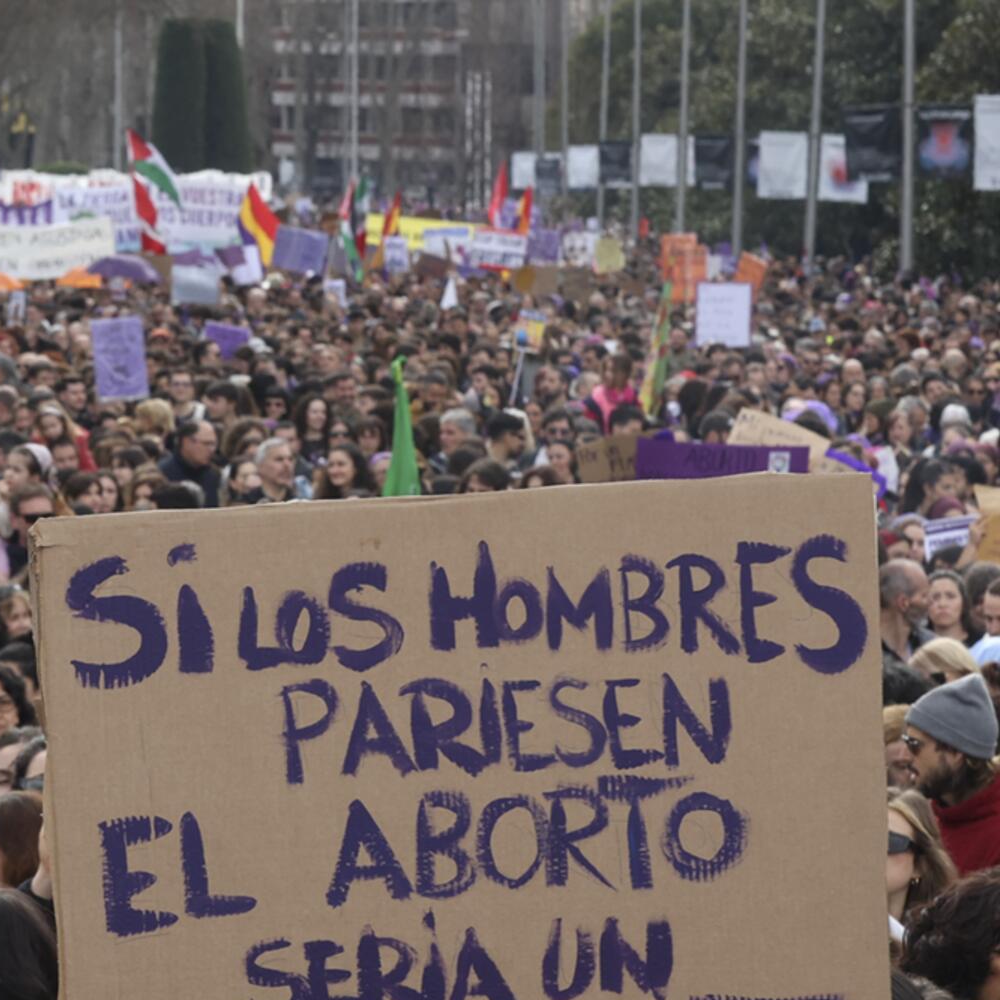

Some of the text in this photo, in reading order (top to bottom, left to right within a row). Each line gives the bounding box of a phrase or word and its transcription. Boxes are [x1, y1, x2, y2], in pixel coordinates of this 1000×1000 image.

[282, 672, 733, 785] PARIESEN
[99, 775, 749, 938] EL ABORTO
